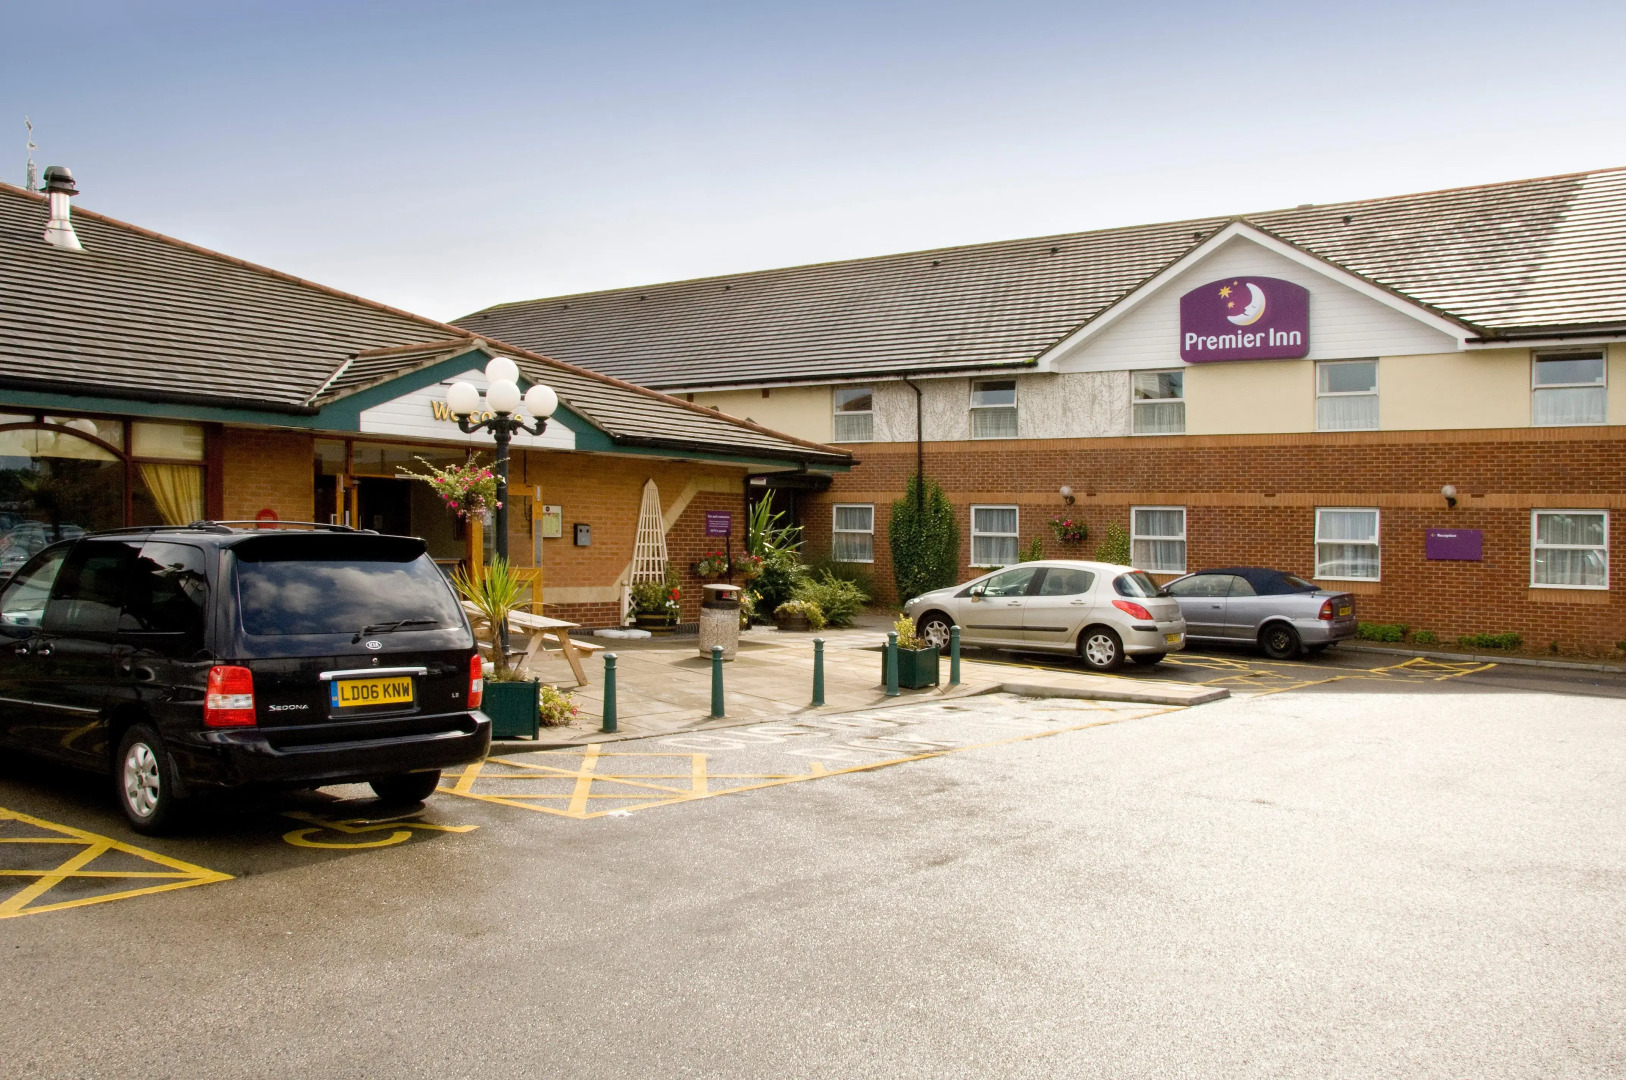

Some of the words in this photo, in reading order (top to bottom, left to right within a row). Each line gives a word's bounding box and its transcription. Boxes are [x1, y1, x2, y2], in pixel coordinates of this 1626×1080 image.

[1185, 330, 1265, 351] Premier
[1269, 327, 1301, 347] Inn
[432, 400, 523, 424] Wecoe
[341, 684, 379, 701] LD06
[382, 682, 410, 699] KNW
